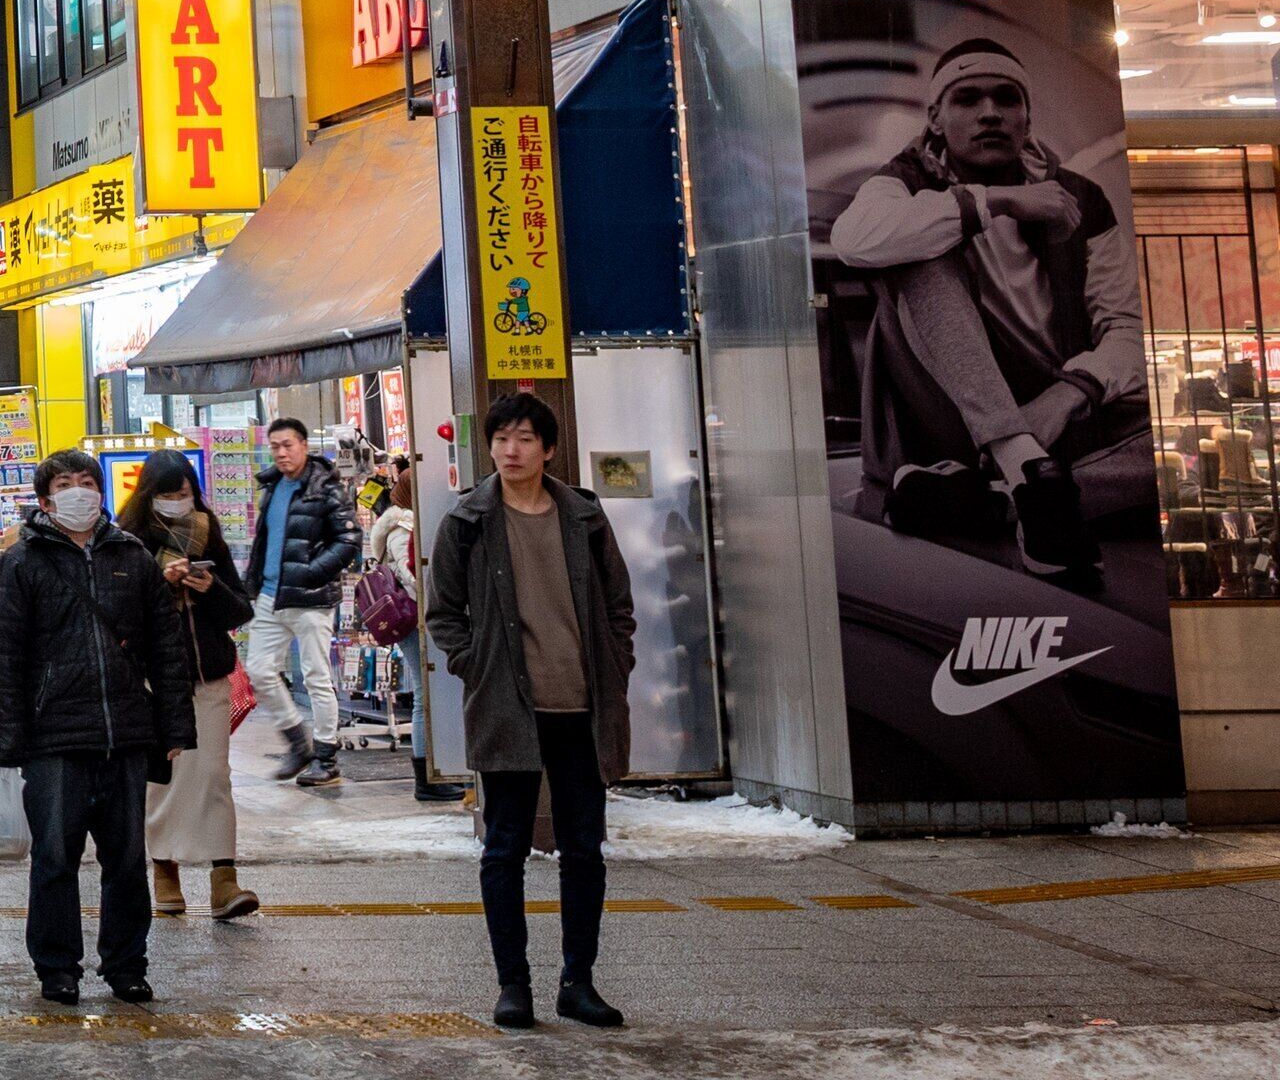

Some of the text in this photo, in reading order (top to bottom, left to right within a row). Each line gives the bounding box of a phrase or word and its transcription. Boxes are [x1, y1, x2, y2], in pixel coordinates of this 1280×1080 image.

[91, 178, 126, 225] 薬
[482, 117, 514, 271] ご通行ください
[518, 114, 549, 268] 自転車から降りて
[9, 216, 22, 268] 薬
[497, 359, 556, 371] 中央警察署
[507, 345, 544, 356] 札幌市
[954, 616, 1069, 672] NIKE
